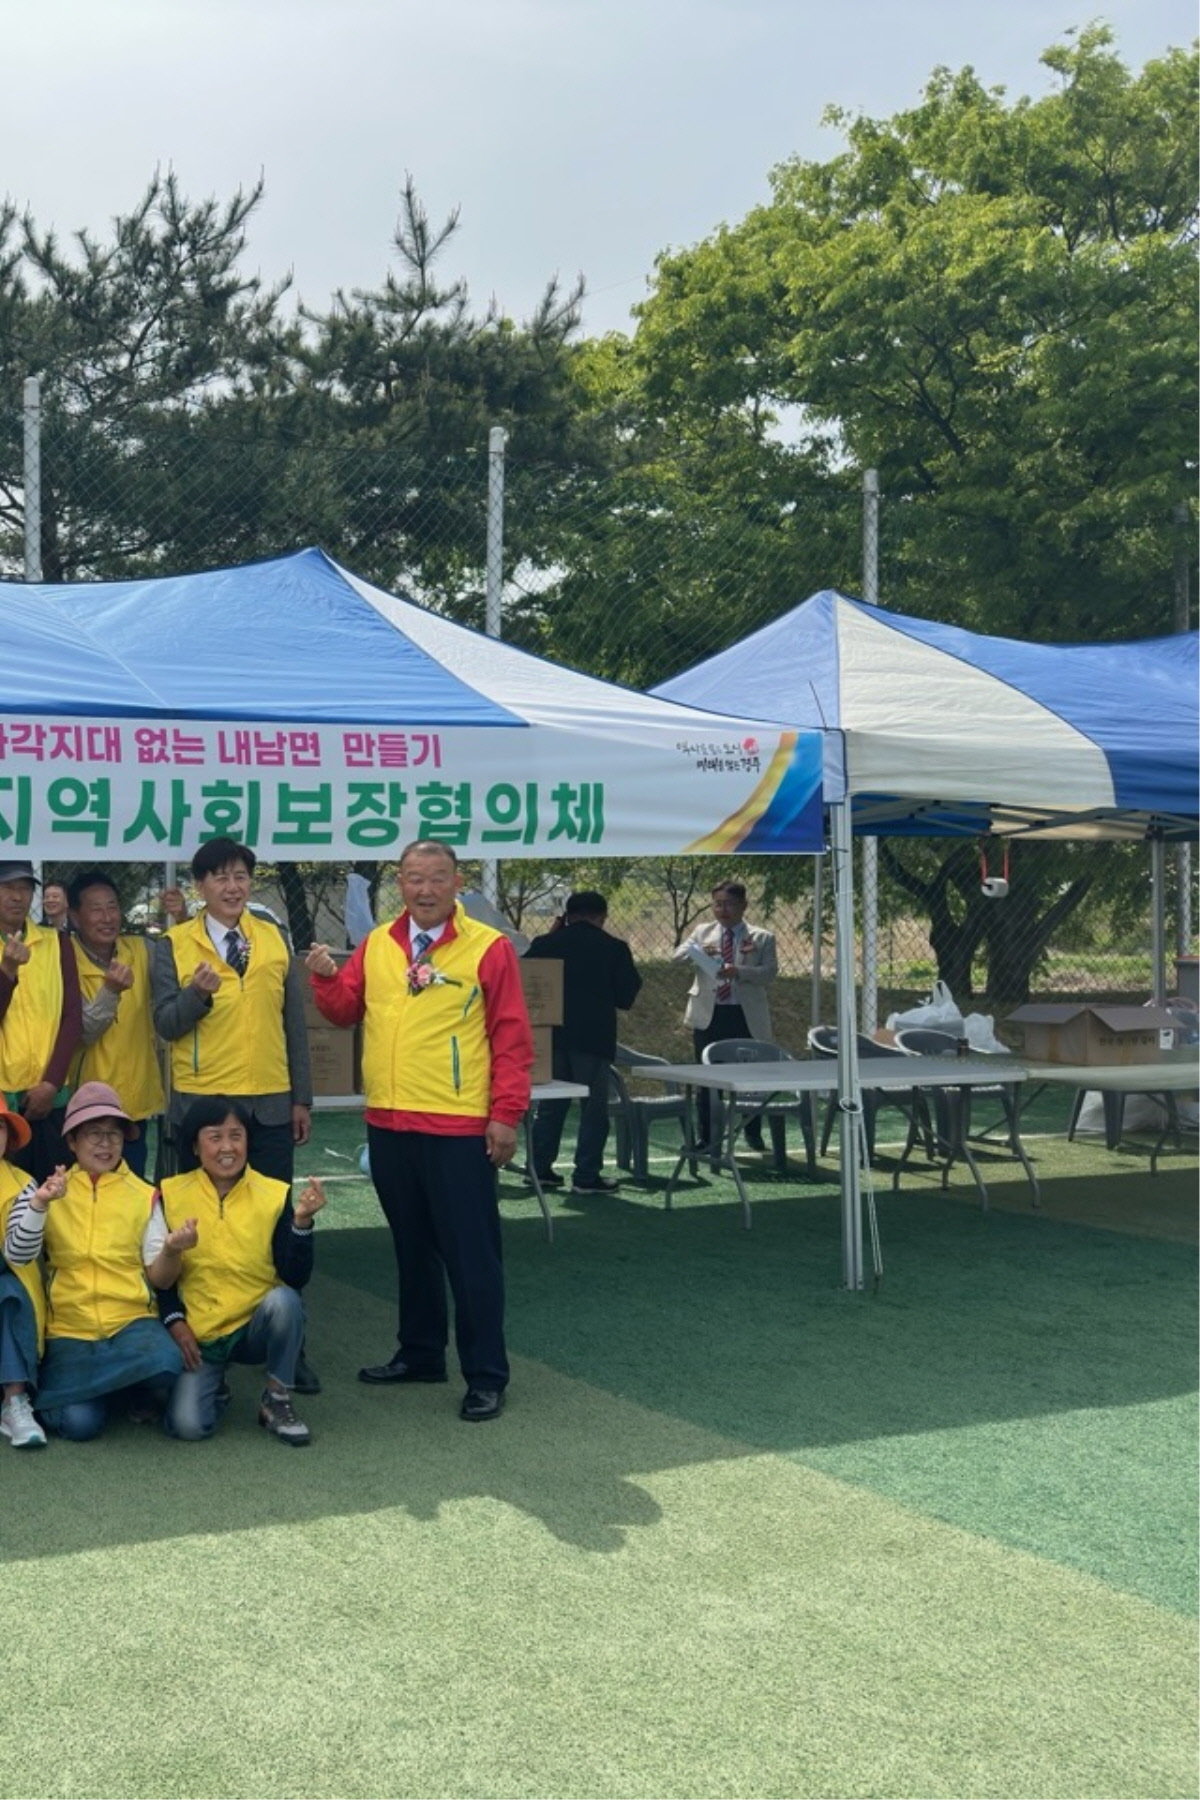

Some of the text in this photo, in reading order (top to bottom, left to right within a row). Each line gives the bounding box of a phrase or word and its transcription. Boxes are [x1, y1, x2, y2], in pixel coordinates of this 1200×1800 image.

[134, 727, 205, 766] 없는
[217, 730, 322, 768] 내남면
[343, 733, 442, 768] 만들기
